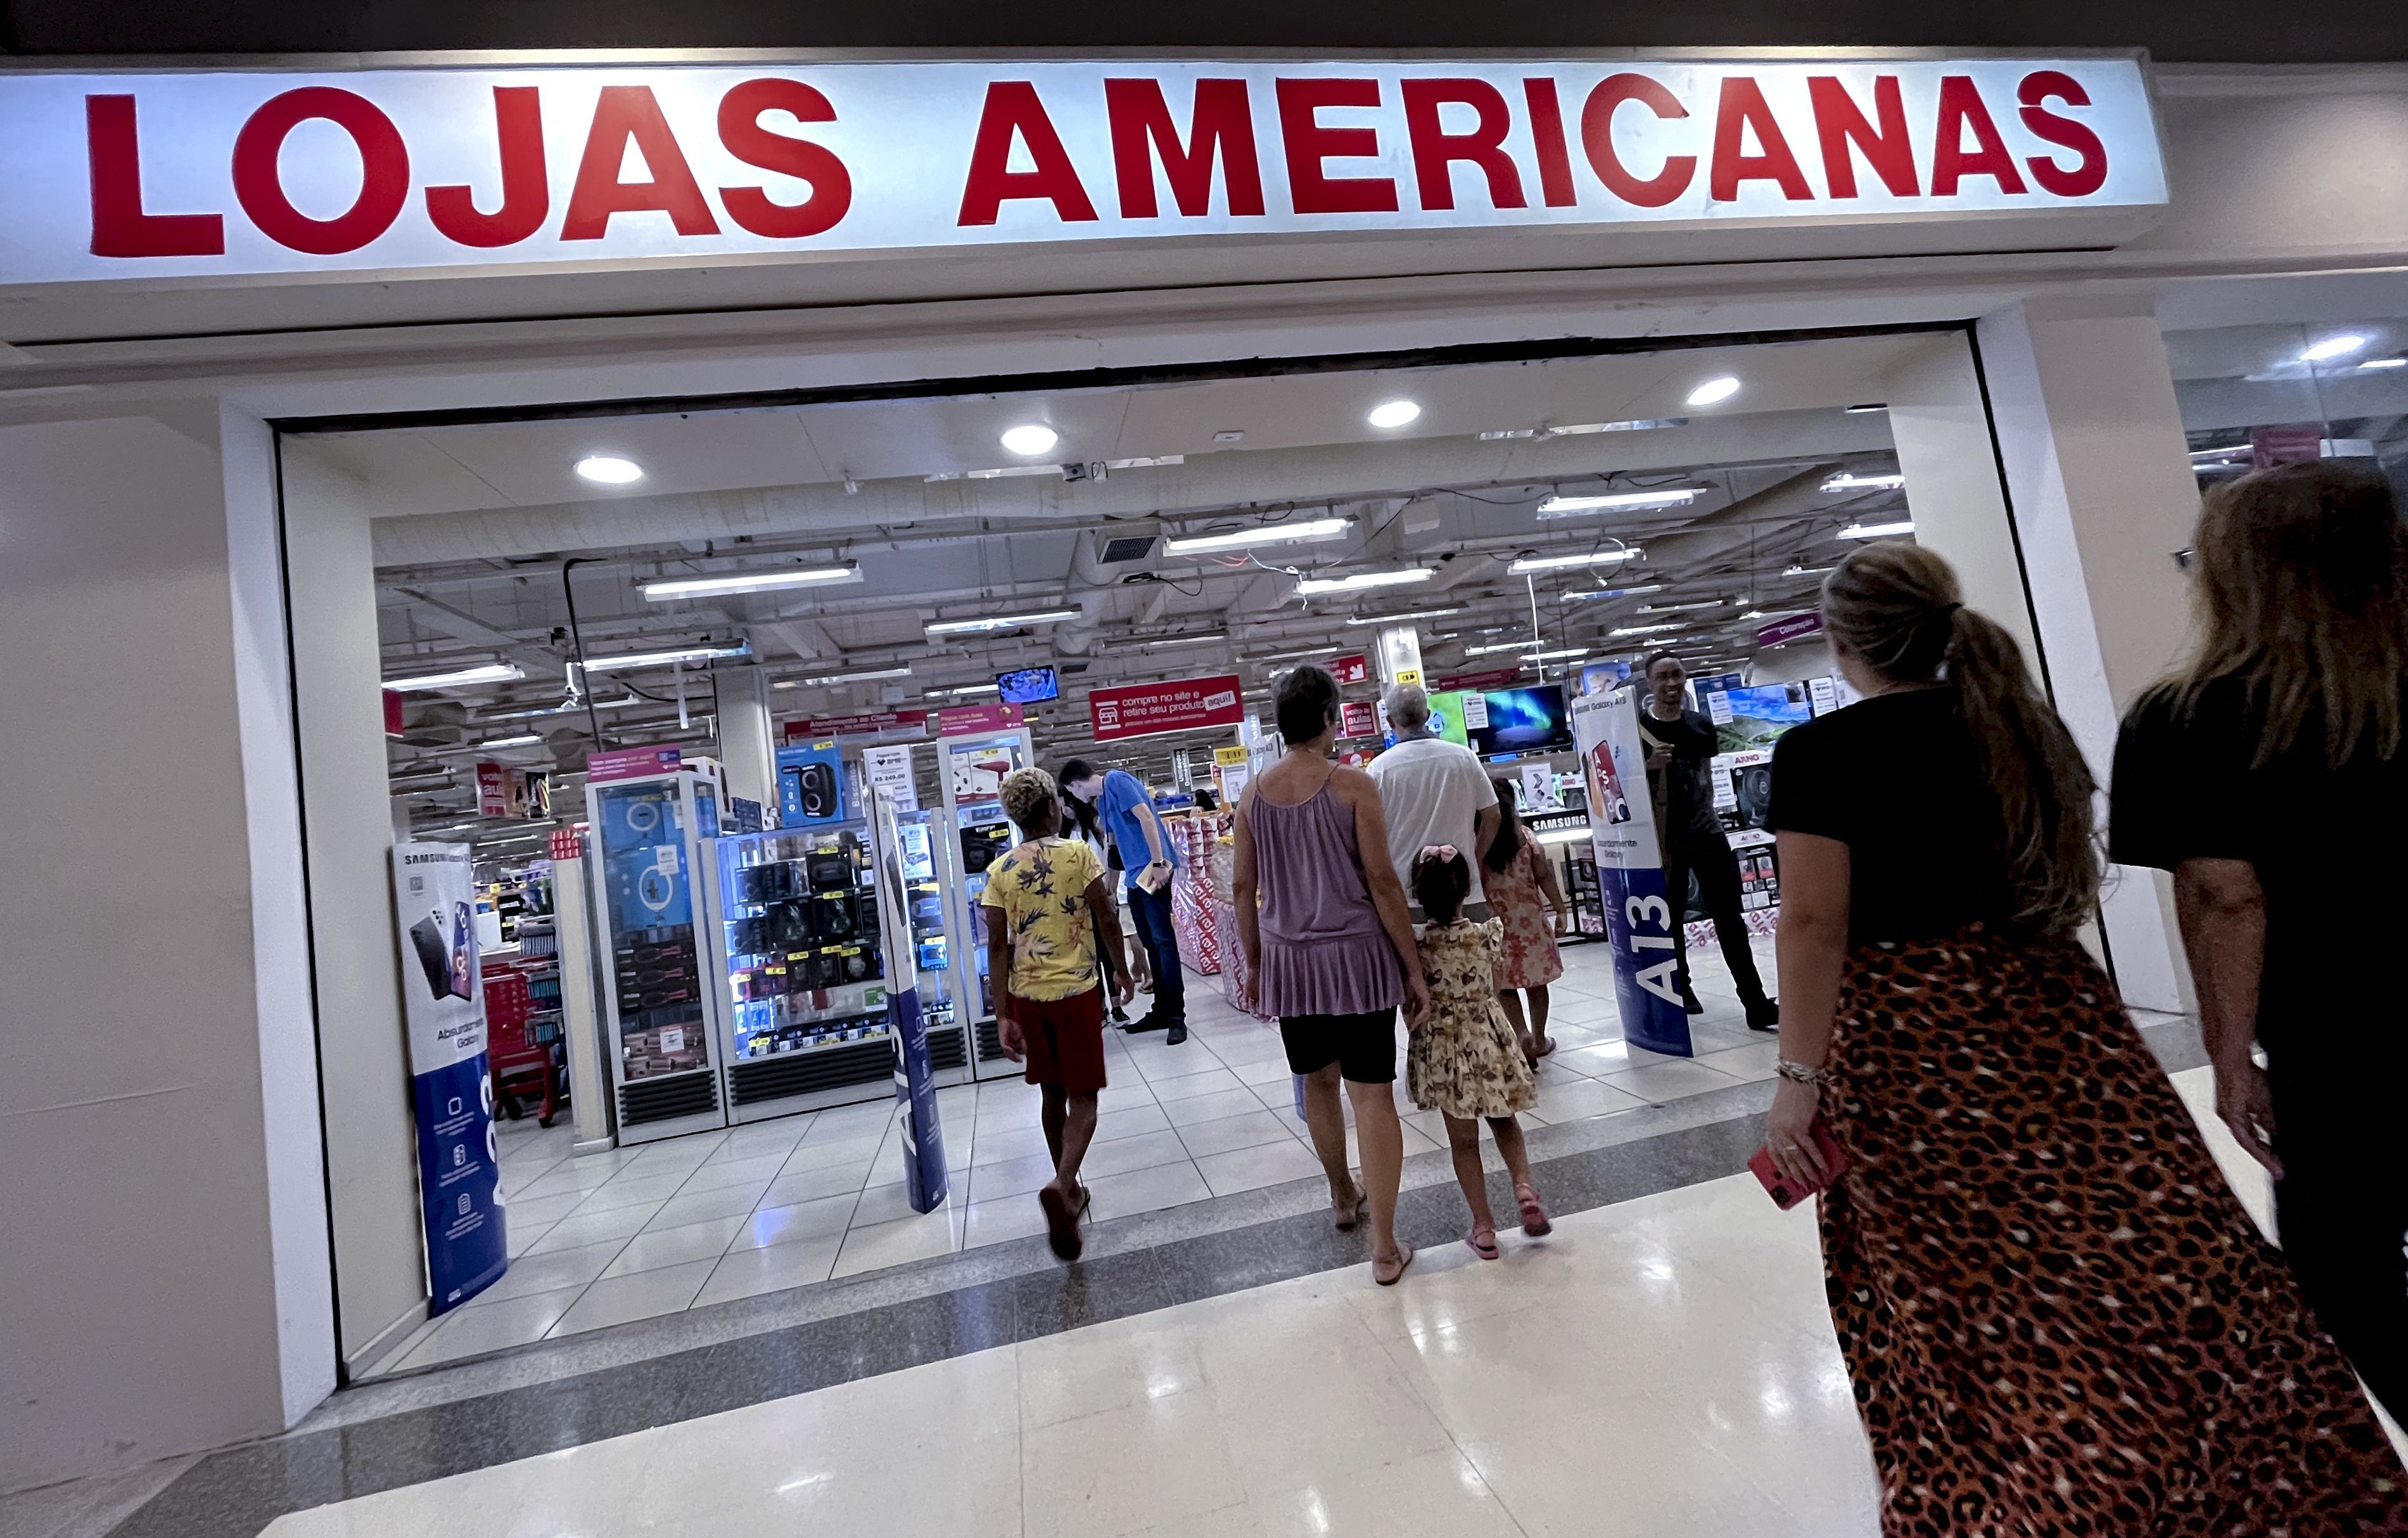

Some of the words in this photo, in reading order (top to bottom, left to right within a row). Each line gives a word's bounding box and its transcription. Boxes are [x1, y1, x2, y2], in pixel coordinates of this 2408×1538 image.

[86, 79, 852, 257] LOJAS
[957, 70, 2106, 226] AMERICANAS
[1122, 695, 1158, 707] compre
[1161, 694, 1172, 702] no
[1175, 691, 1191, 701] site
[1123, 706, 1147, 717] retire
[1149, 705, 1167, 714] seu
[1169, 700, 1204, 714] produto
[1207, 693, 1231, 707] aqui!
[1735, 753, 1760, 764] ARNO
[1532, 814, 1587, 831] SAMSUNG
[1625, 895, 1685, 1008] A13
